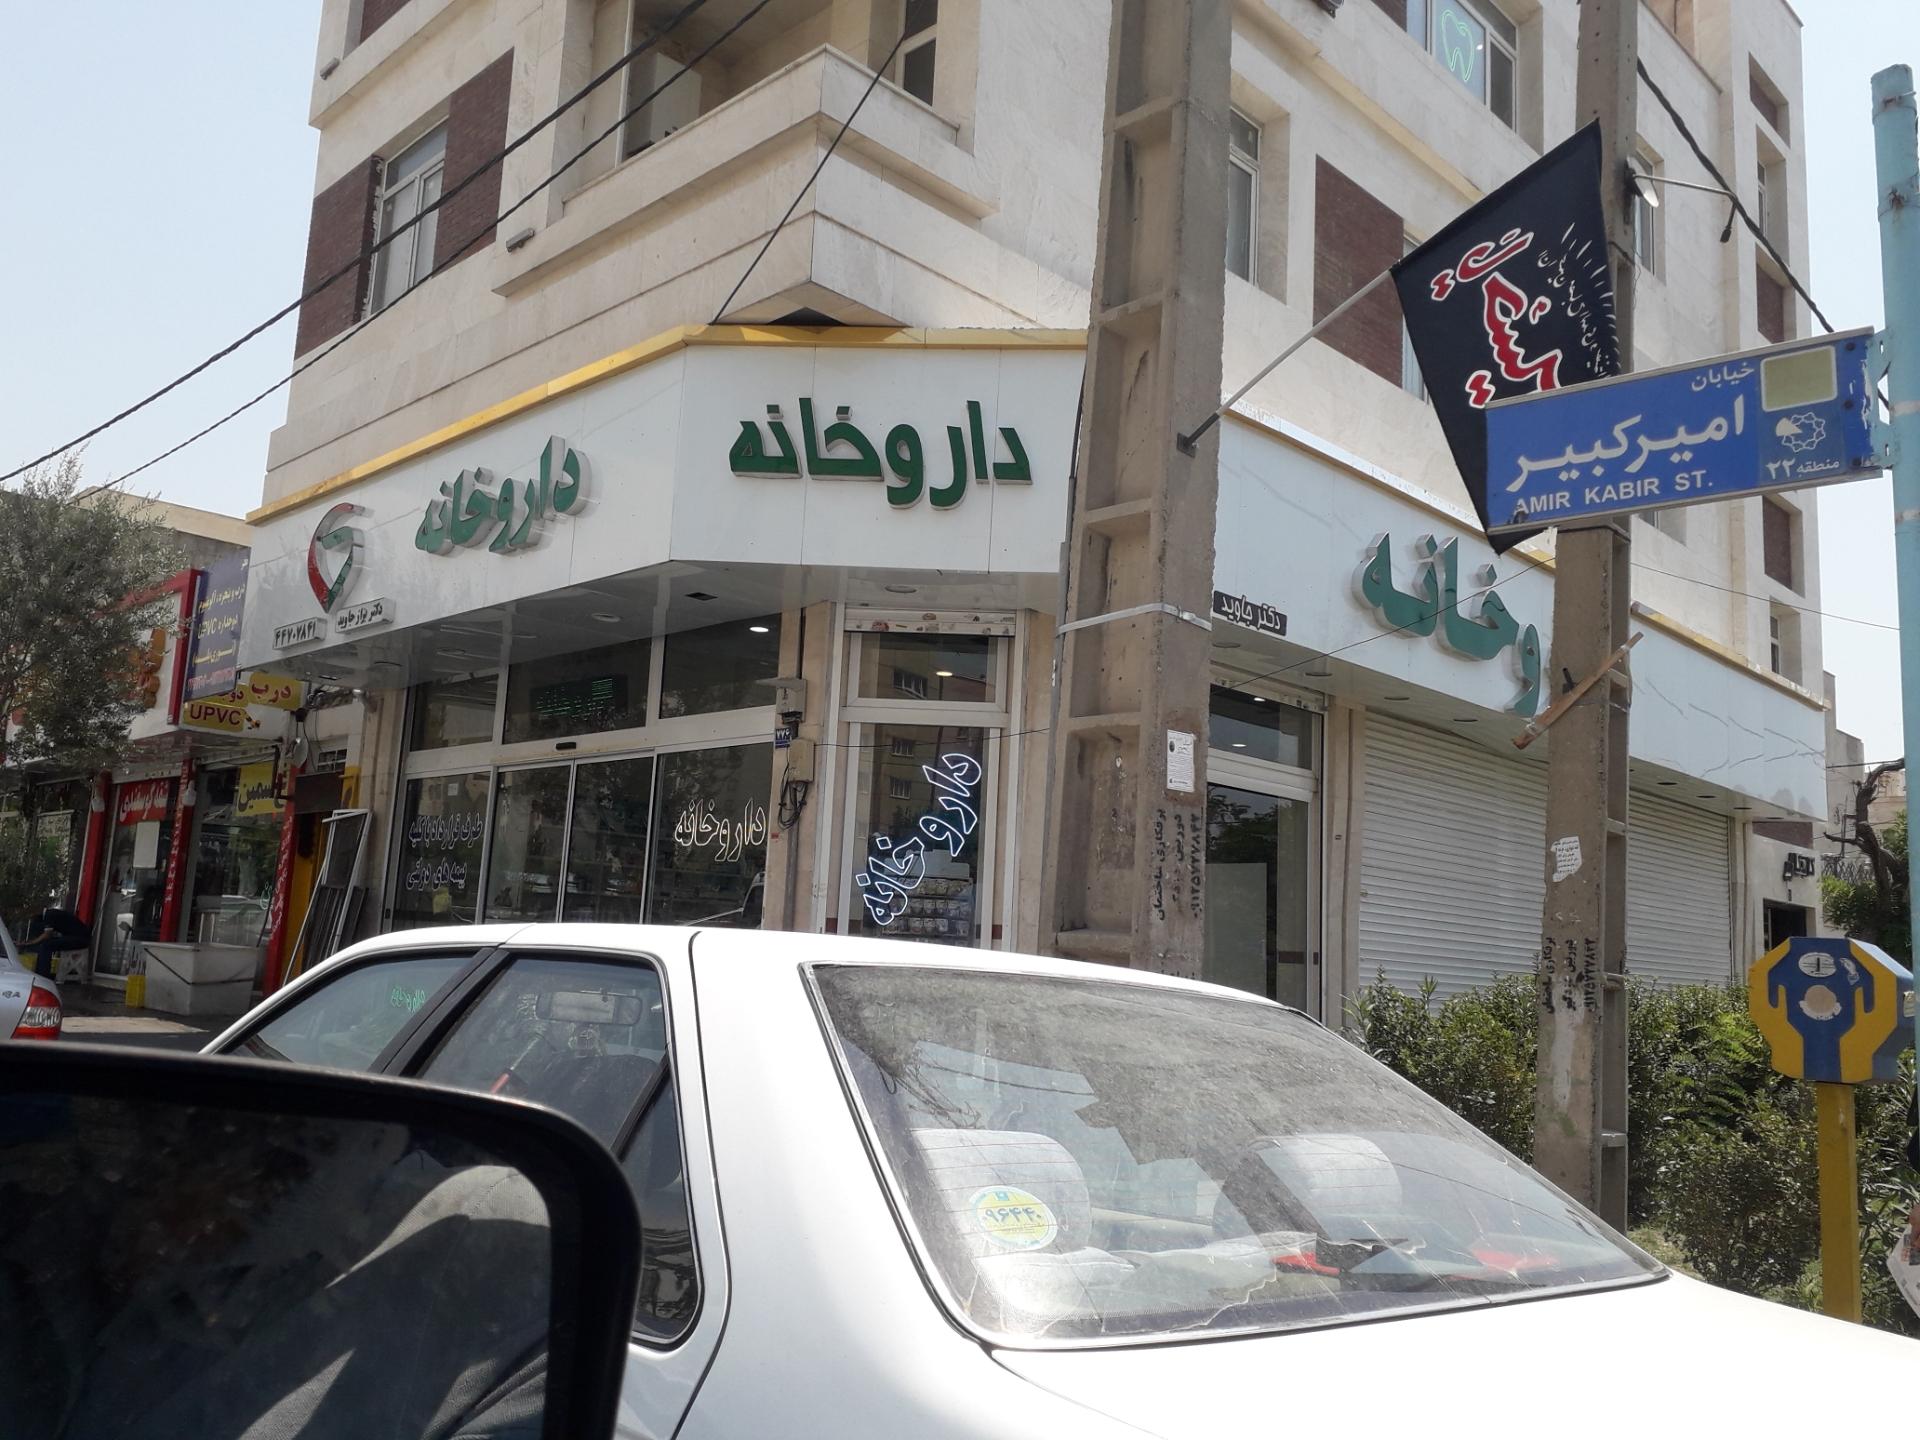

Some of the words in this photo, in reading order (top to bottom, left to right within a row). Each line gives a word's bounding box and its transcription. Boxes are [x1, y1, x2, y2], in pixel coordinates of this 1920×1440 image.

[1691, 362, 1755, 391] خیابان
[729, 397, 1033, 510] داروخانه
[1766, 458, 1796, 480] ۲۲
[1796, 460, 1840, 477] منطقه
[415, 435, 588, 554] داروخانه
[1514, 491, 1571, 516] AMIR
[1585, 478, 1660, 504] KABIR
[1674, 470, 1713, 491] ST.
[368, 602, 383, 621] دکتر
[1221, 595, 1253, 625] جاوید
[1257, 604, 1281, 630] دکتر
[251, 683, 292, 703] درب
[190, 704, 241, 726] UPVC
[461, 812, 484, 848] طرف
[674, 797, 767, 862] داروخانه
[856, 753, 981, 925] داروخانه
